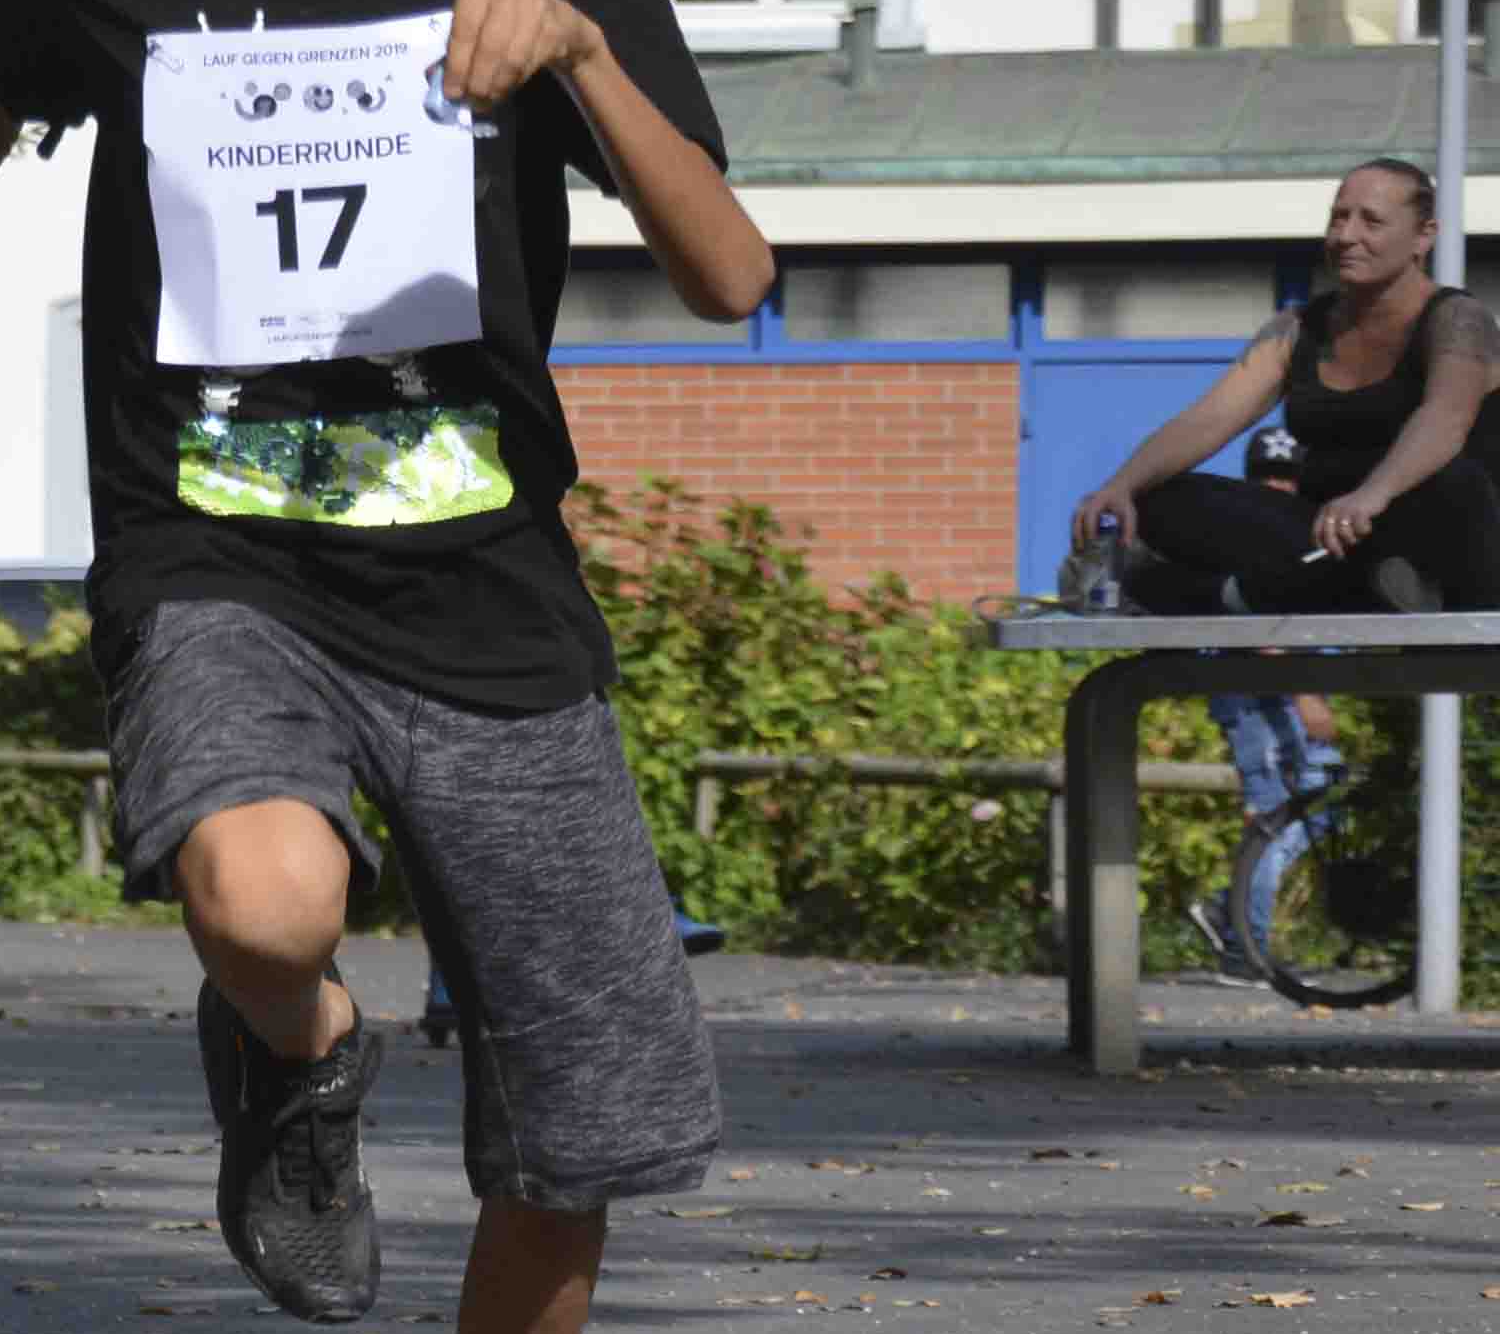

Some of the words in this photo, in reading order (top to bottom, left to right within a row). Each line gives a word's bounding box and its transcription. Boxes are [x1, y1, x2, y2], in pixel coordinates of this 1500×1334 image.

[203, 53, 239, 67] LAUF
[242, 51, 293, 66] GEGEN
[297, 47, 370, 64] GRENZEN
[374, 42, 408, 56] 2019
[208, 133, 412, 169] KINDERRUNDE
[256, 183, 367, 273] 17
